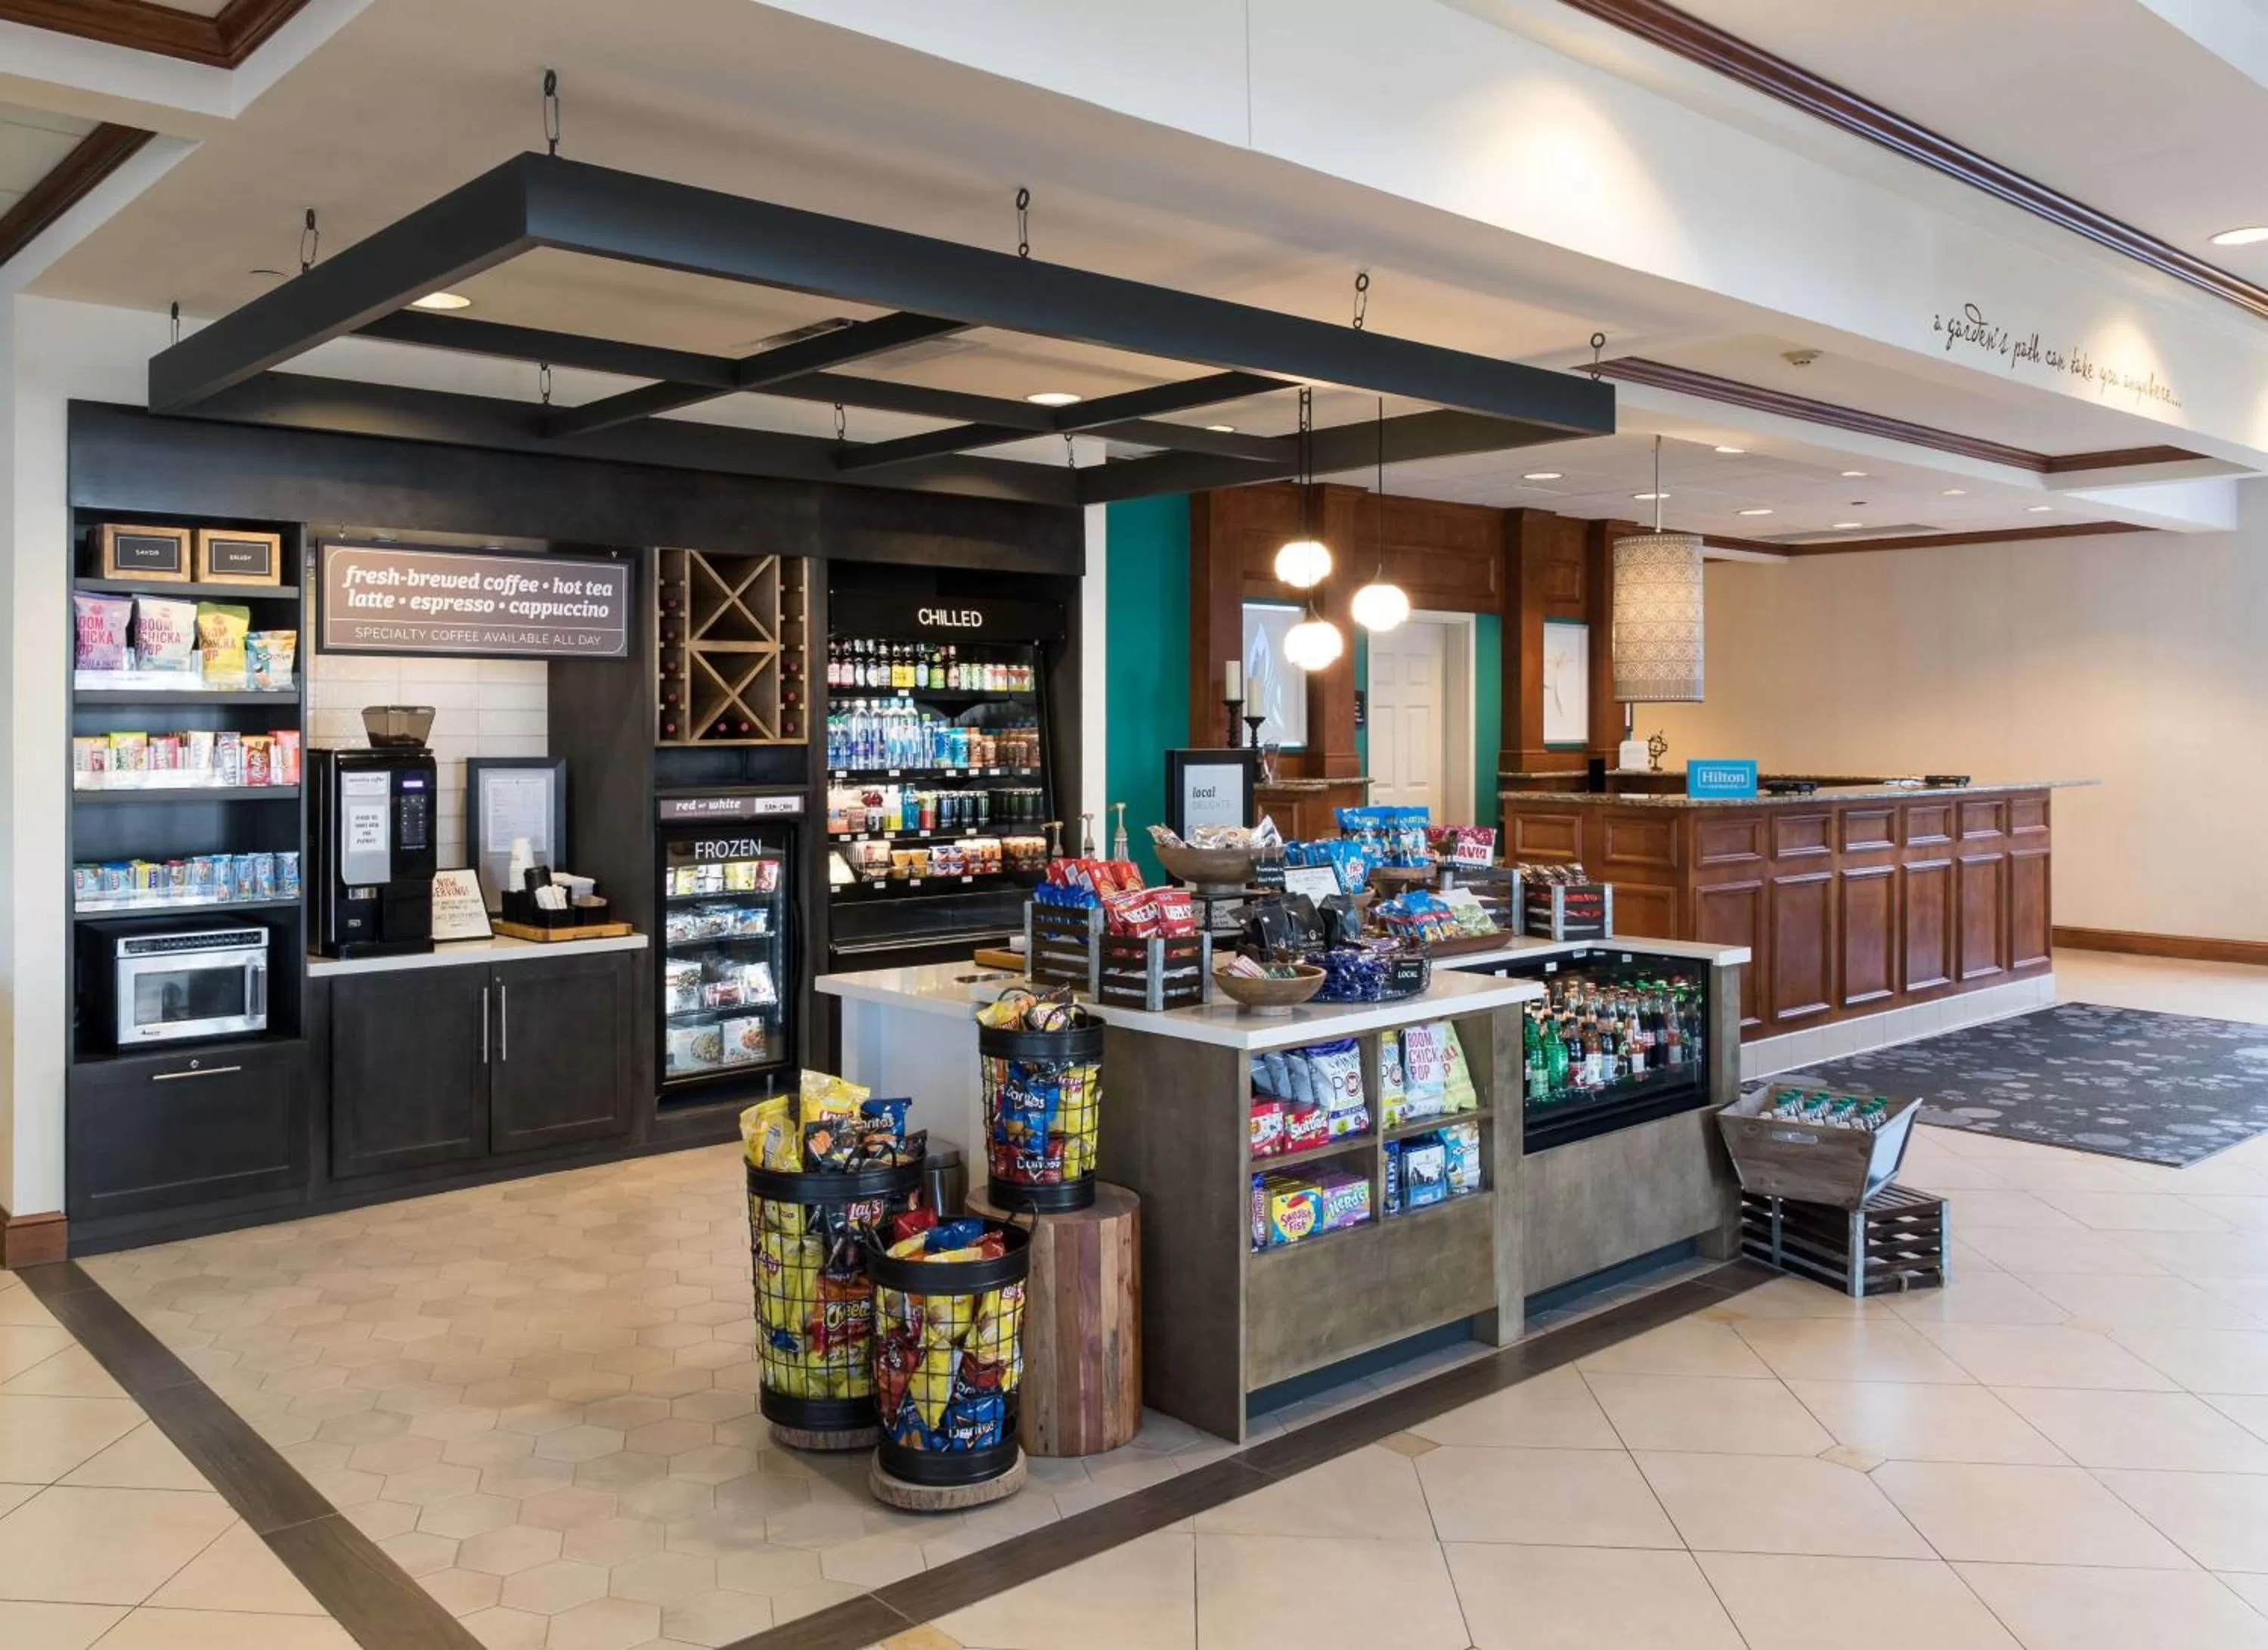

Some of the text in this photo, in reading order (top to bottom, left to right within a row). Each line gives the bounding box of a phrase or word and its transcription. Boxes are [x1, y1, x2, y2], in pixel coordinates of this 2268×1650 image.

[1933, 314, 1942, 331] a
[1945, 302, 2008, 355] garden's
[2011, 333, 2042, 370] path
[2045, 349, 2065, 373] can
[2070, 345, 2094, 382] take
[342, 564, 613, 597] fresh-brewed coffee hot tea
[347, 588, 609, 619] latte espresso cappuccino
[918, 607, 984, 628] CHILLED
[355, 626, 602, 646] SPECIALTY COFFEE AVAILABLE ALL DAY
[1701, 771, 1746, 783] Hilton
[1192, 786, 1216, 799] local
[675, 799, 696, 812] red
[708, 798, 742, 810] white
[694, 838, 763, 860] FROZEN
